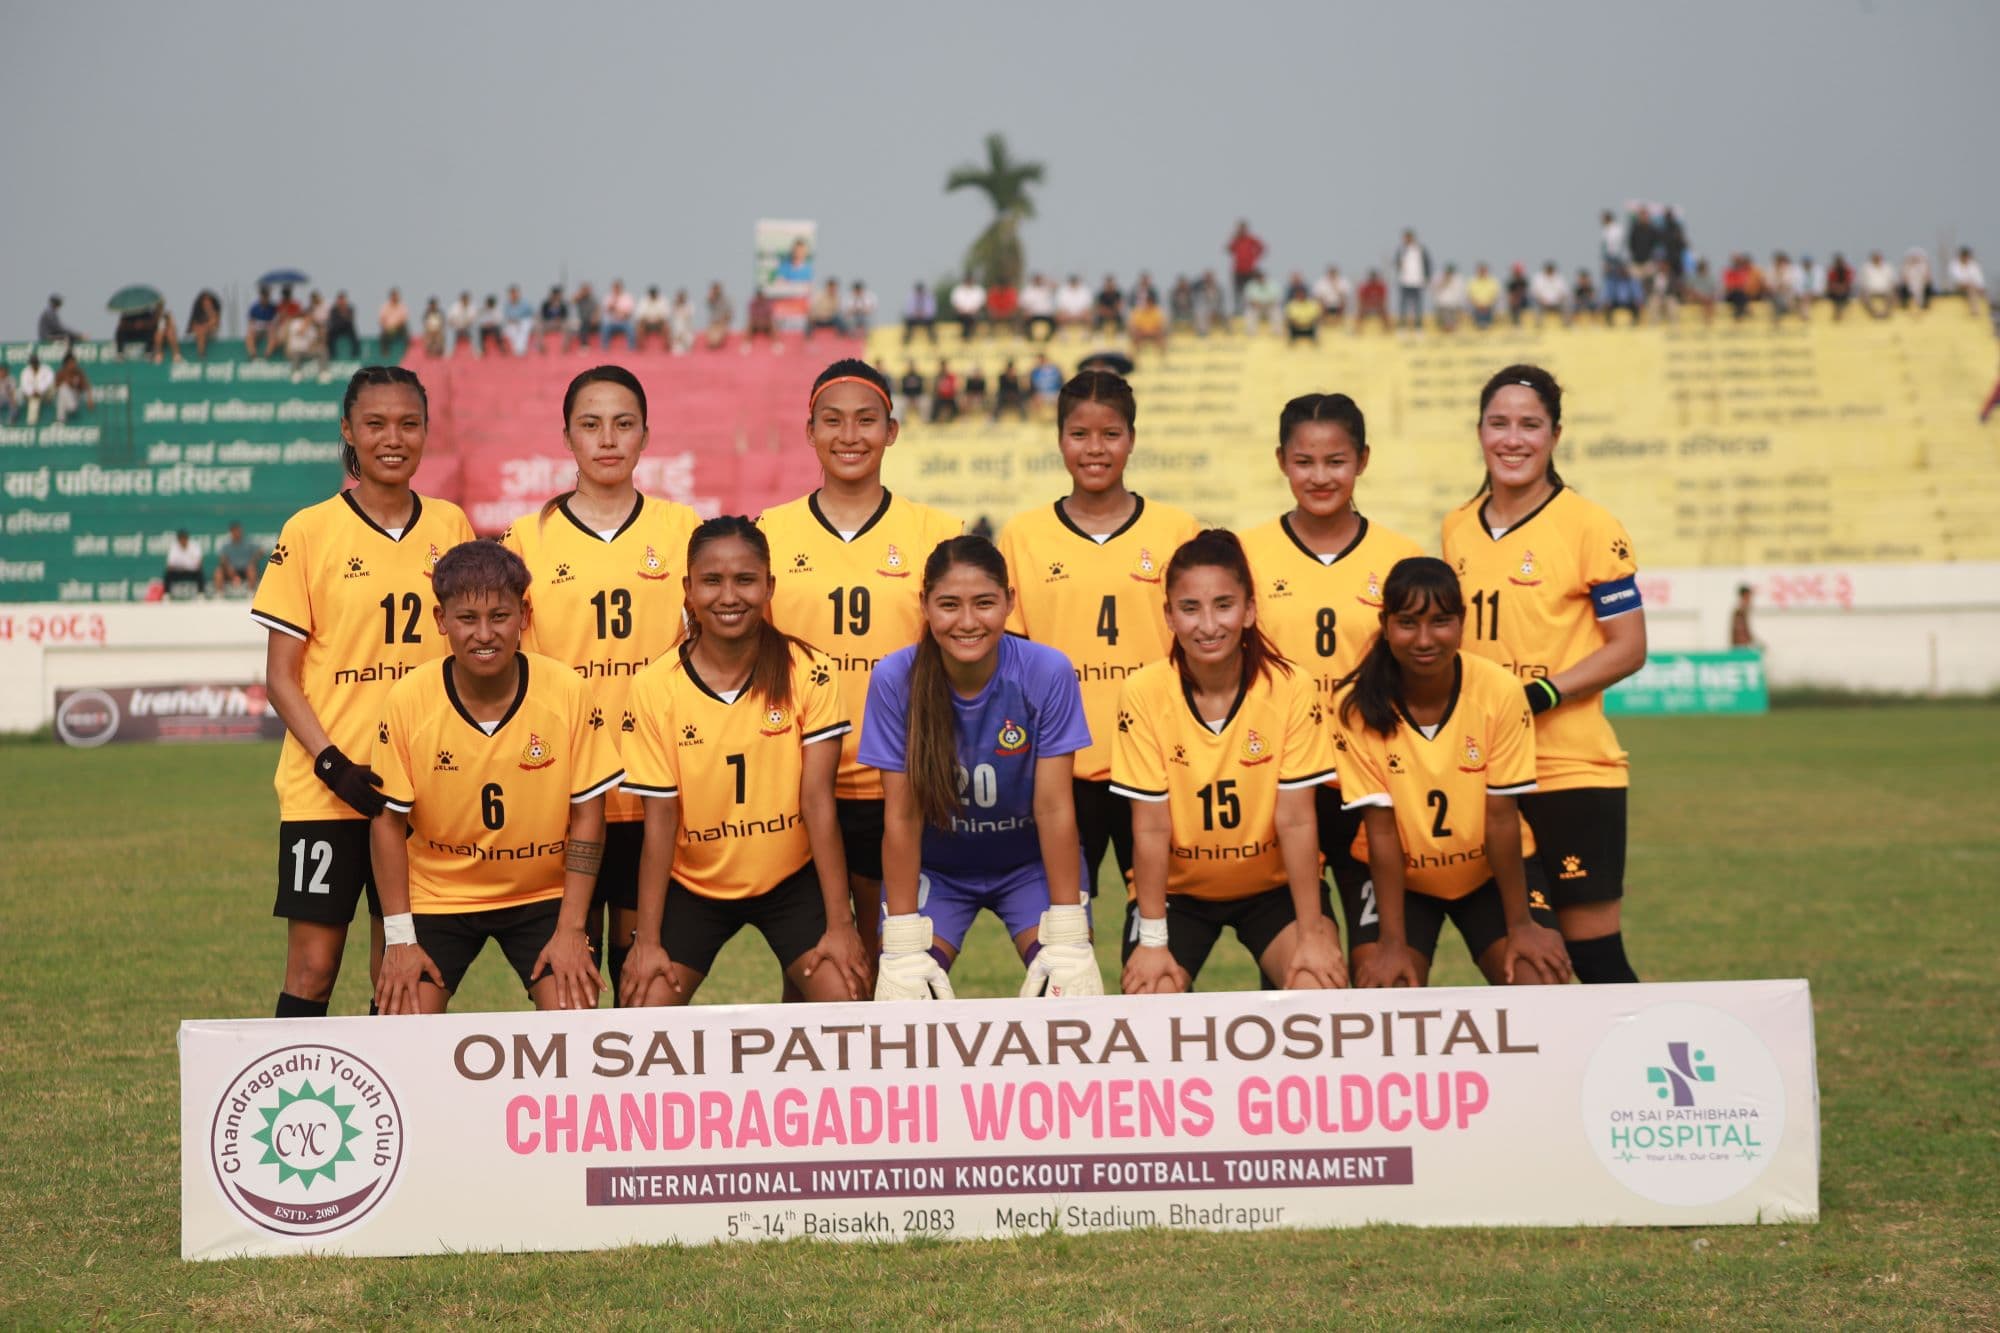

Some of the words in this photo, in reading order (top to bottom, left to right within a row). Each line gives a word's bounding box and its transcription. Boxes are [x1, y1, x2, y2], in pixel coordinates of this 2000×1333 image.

[344, 571, 371, 579] KELME
[380, 591, 422, 644] 12
[590, 588, 632, 640] 13
[828, 586, 870, 636] 19
[1096, 595, 1119, 646] 4
[1315, 607, 1336, 657] 8
[1471, 588, 1499, 640] 11
[481, 782, 505, 831] 6
[1196, 779, 1241, 831] 15
[1427, 789, 1453, 838] 2
[291, 838, 333, 894] 12
[429, 839, 565, 861] mahindra
[453, 1032, 569, 1081] OM
[591, 1029, 706, 1077] SAI
[730, 1018, 1149, 1074] PATHIVARA
[1169, 1008, 1539, 1062] HOSPITAL
[221, 1054, 321, 1174] Chandragadhi
[329, 1056, 382, 1108] Youth
[374, 1114, 394, 1167] Club
[505, 1085, 938, 1155] CHANDRAGADHI
[961, 1077, 1214, 1142] WOMENS
[1238, 1071, 1489, 1136] GOLDCUP
[1610, 1110, 1634, 1122] OM
[1638, 1110, 1661, 1121] SAI
[1666, 1108, 1760, 1121] PATHIBHARA
[1611, 1124, 1761, 1149] HOSPITAL
[276, 1123, 326, 1157] CYC
[611, 1171, 802, 1198] INTERNATIONAL
[811, 1167, 945, 1192] INVITATION
[956, 1163, 1084, 1188] KNOCKOUT
[1093, 1160, 1215, 1185] FOOTBALL
[1224, 1156, 1388, 1182] TOURNAMENT
[315, 1204, 340, 1220] 2080
[803, 1210, 895, 1234] Baisakh,
[903, 1209, 956, 1232] 2083
[1169, 1203, 1285, 1230] Bhadrapur
